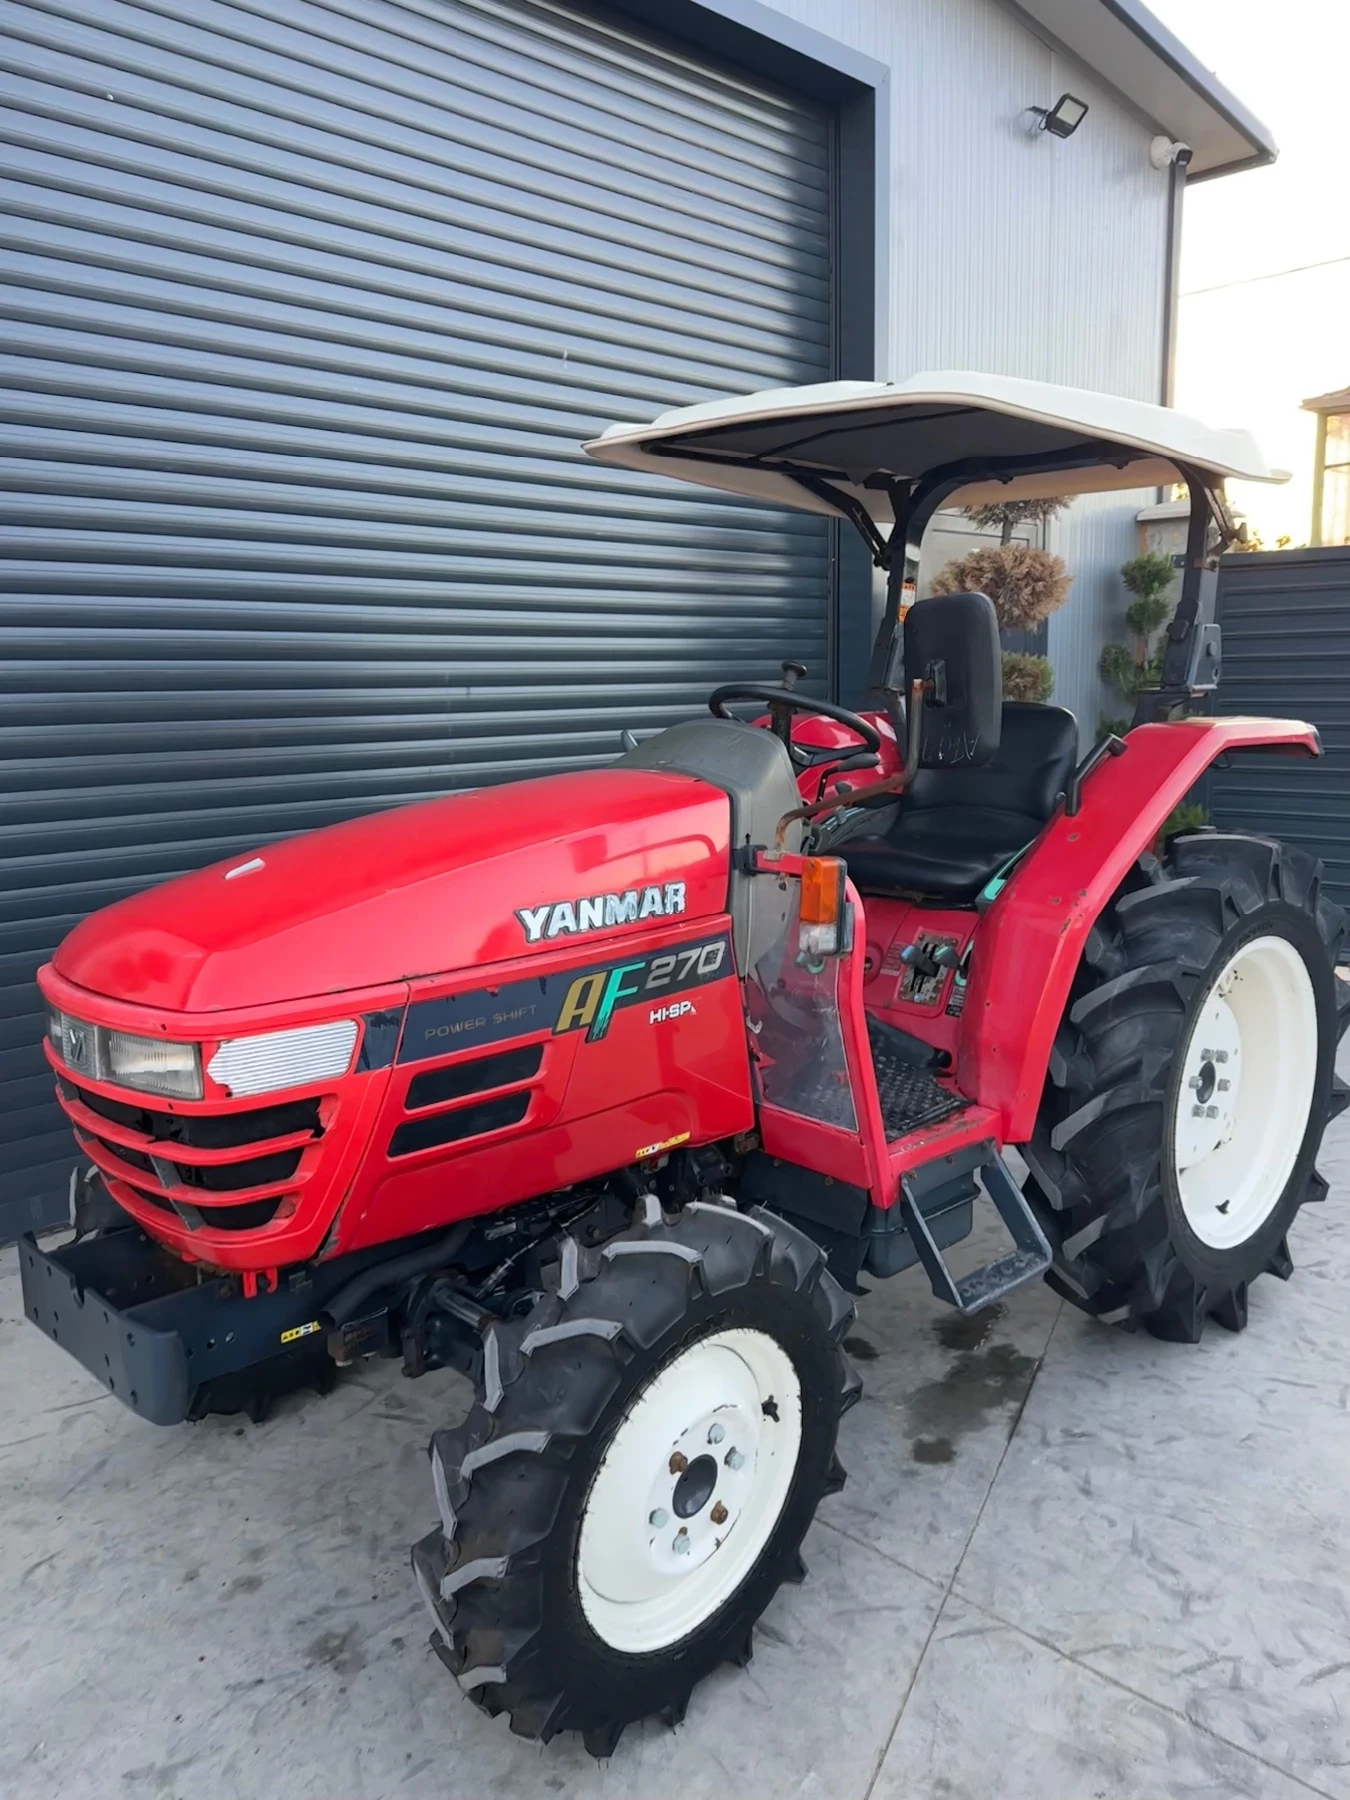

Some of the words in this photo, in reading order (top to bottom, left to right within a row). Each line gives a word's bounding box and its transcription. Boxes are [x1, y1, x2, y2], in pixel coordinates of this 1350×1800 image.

[515, 881, 687, 942] YANMAR
[424, 1017, 487, 1040] POWER
[492, 1004, 538, 1025] SHIFT
